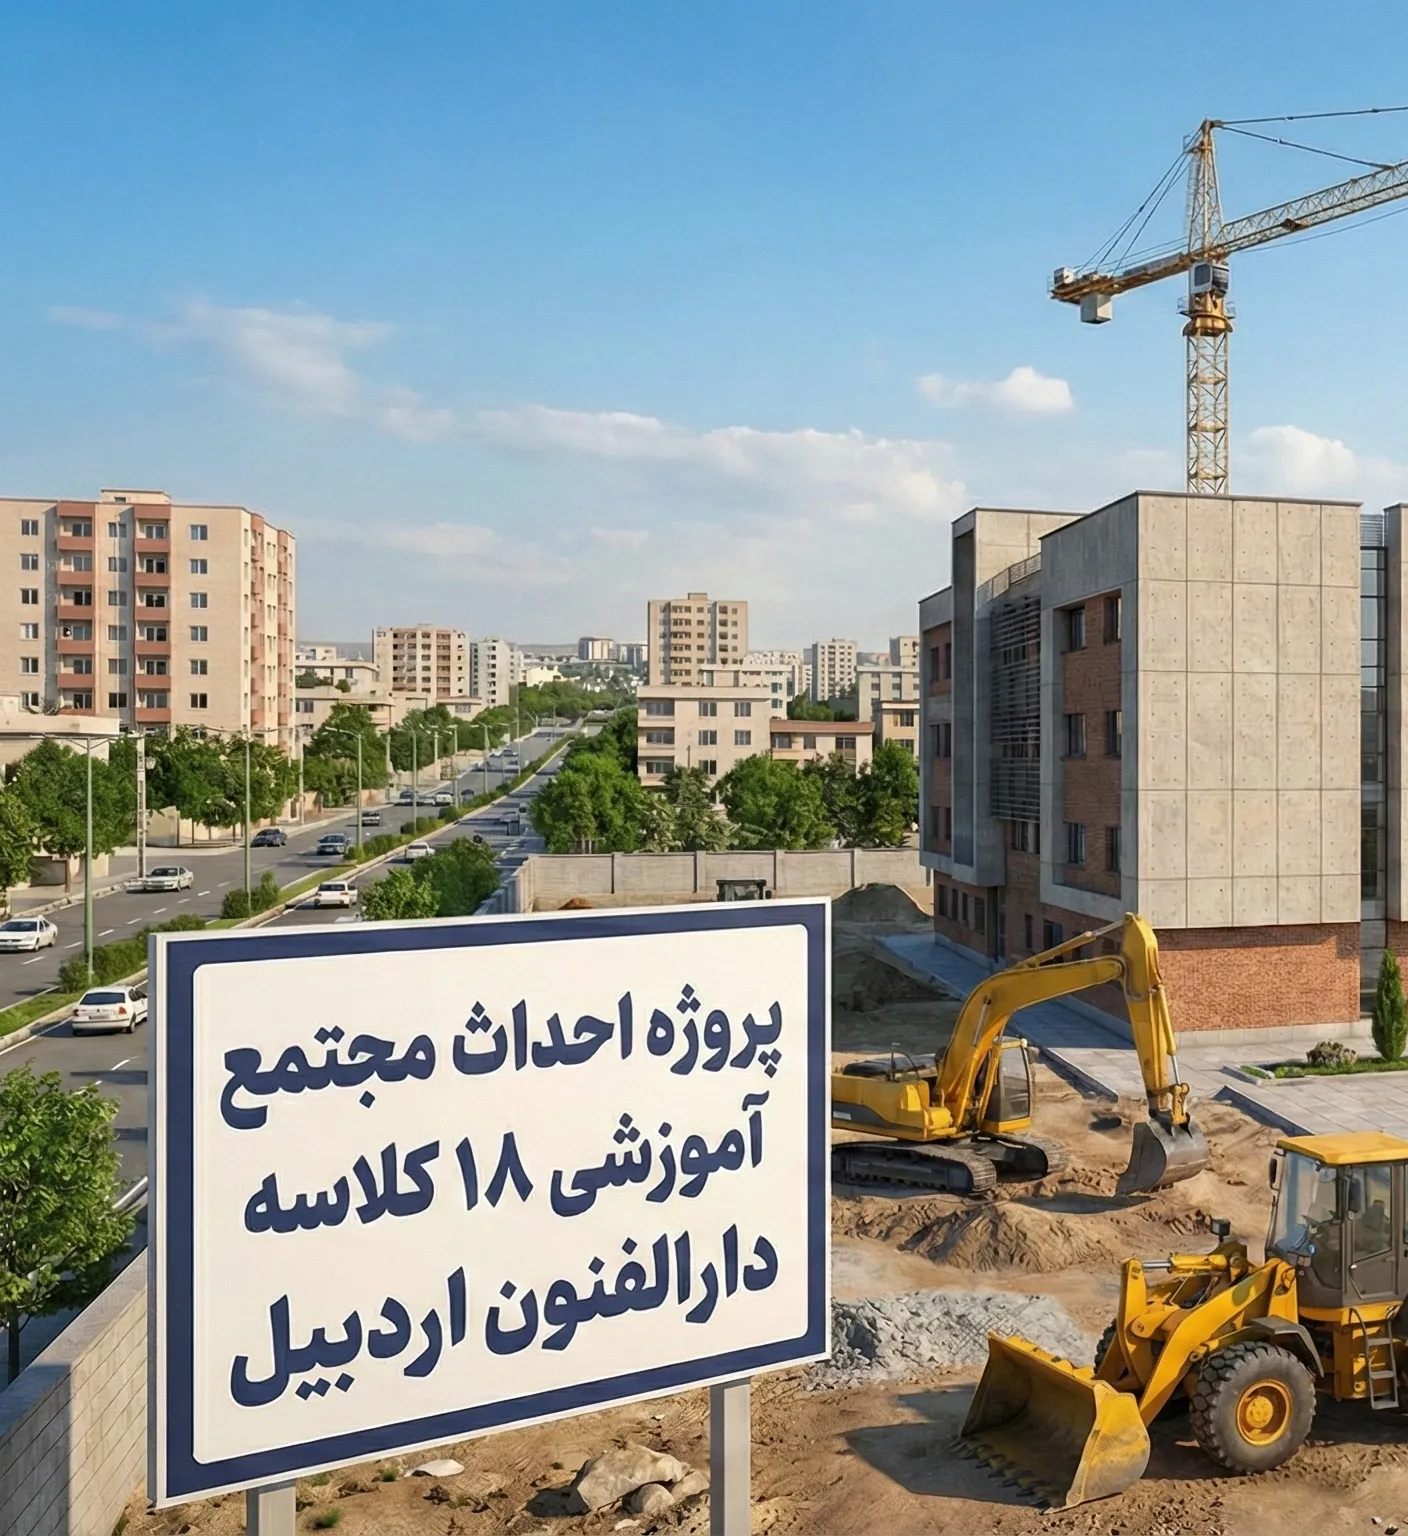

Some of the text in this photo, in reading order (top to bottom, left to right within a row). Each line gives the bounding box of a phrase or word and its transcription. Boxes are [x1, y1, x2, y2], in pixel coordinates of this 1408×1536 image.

[220, 983, 783, 1131] پروژه احداث مجتمع
[244, 1090, 770, 1234] آموزشی ۱۸ کلاسه
[230, 1223, 779, 1408] دارالفنون اردبیل
